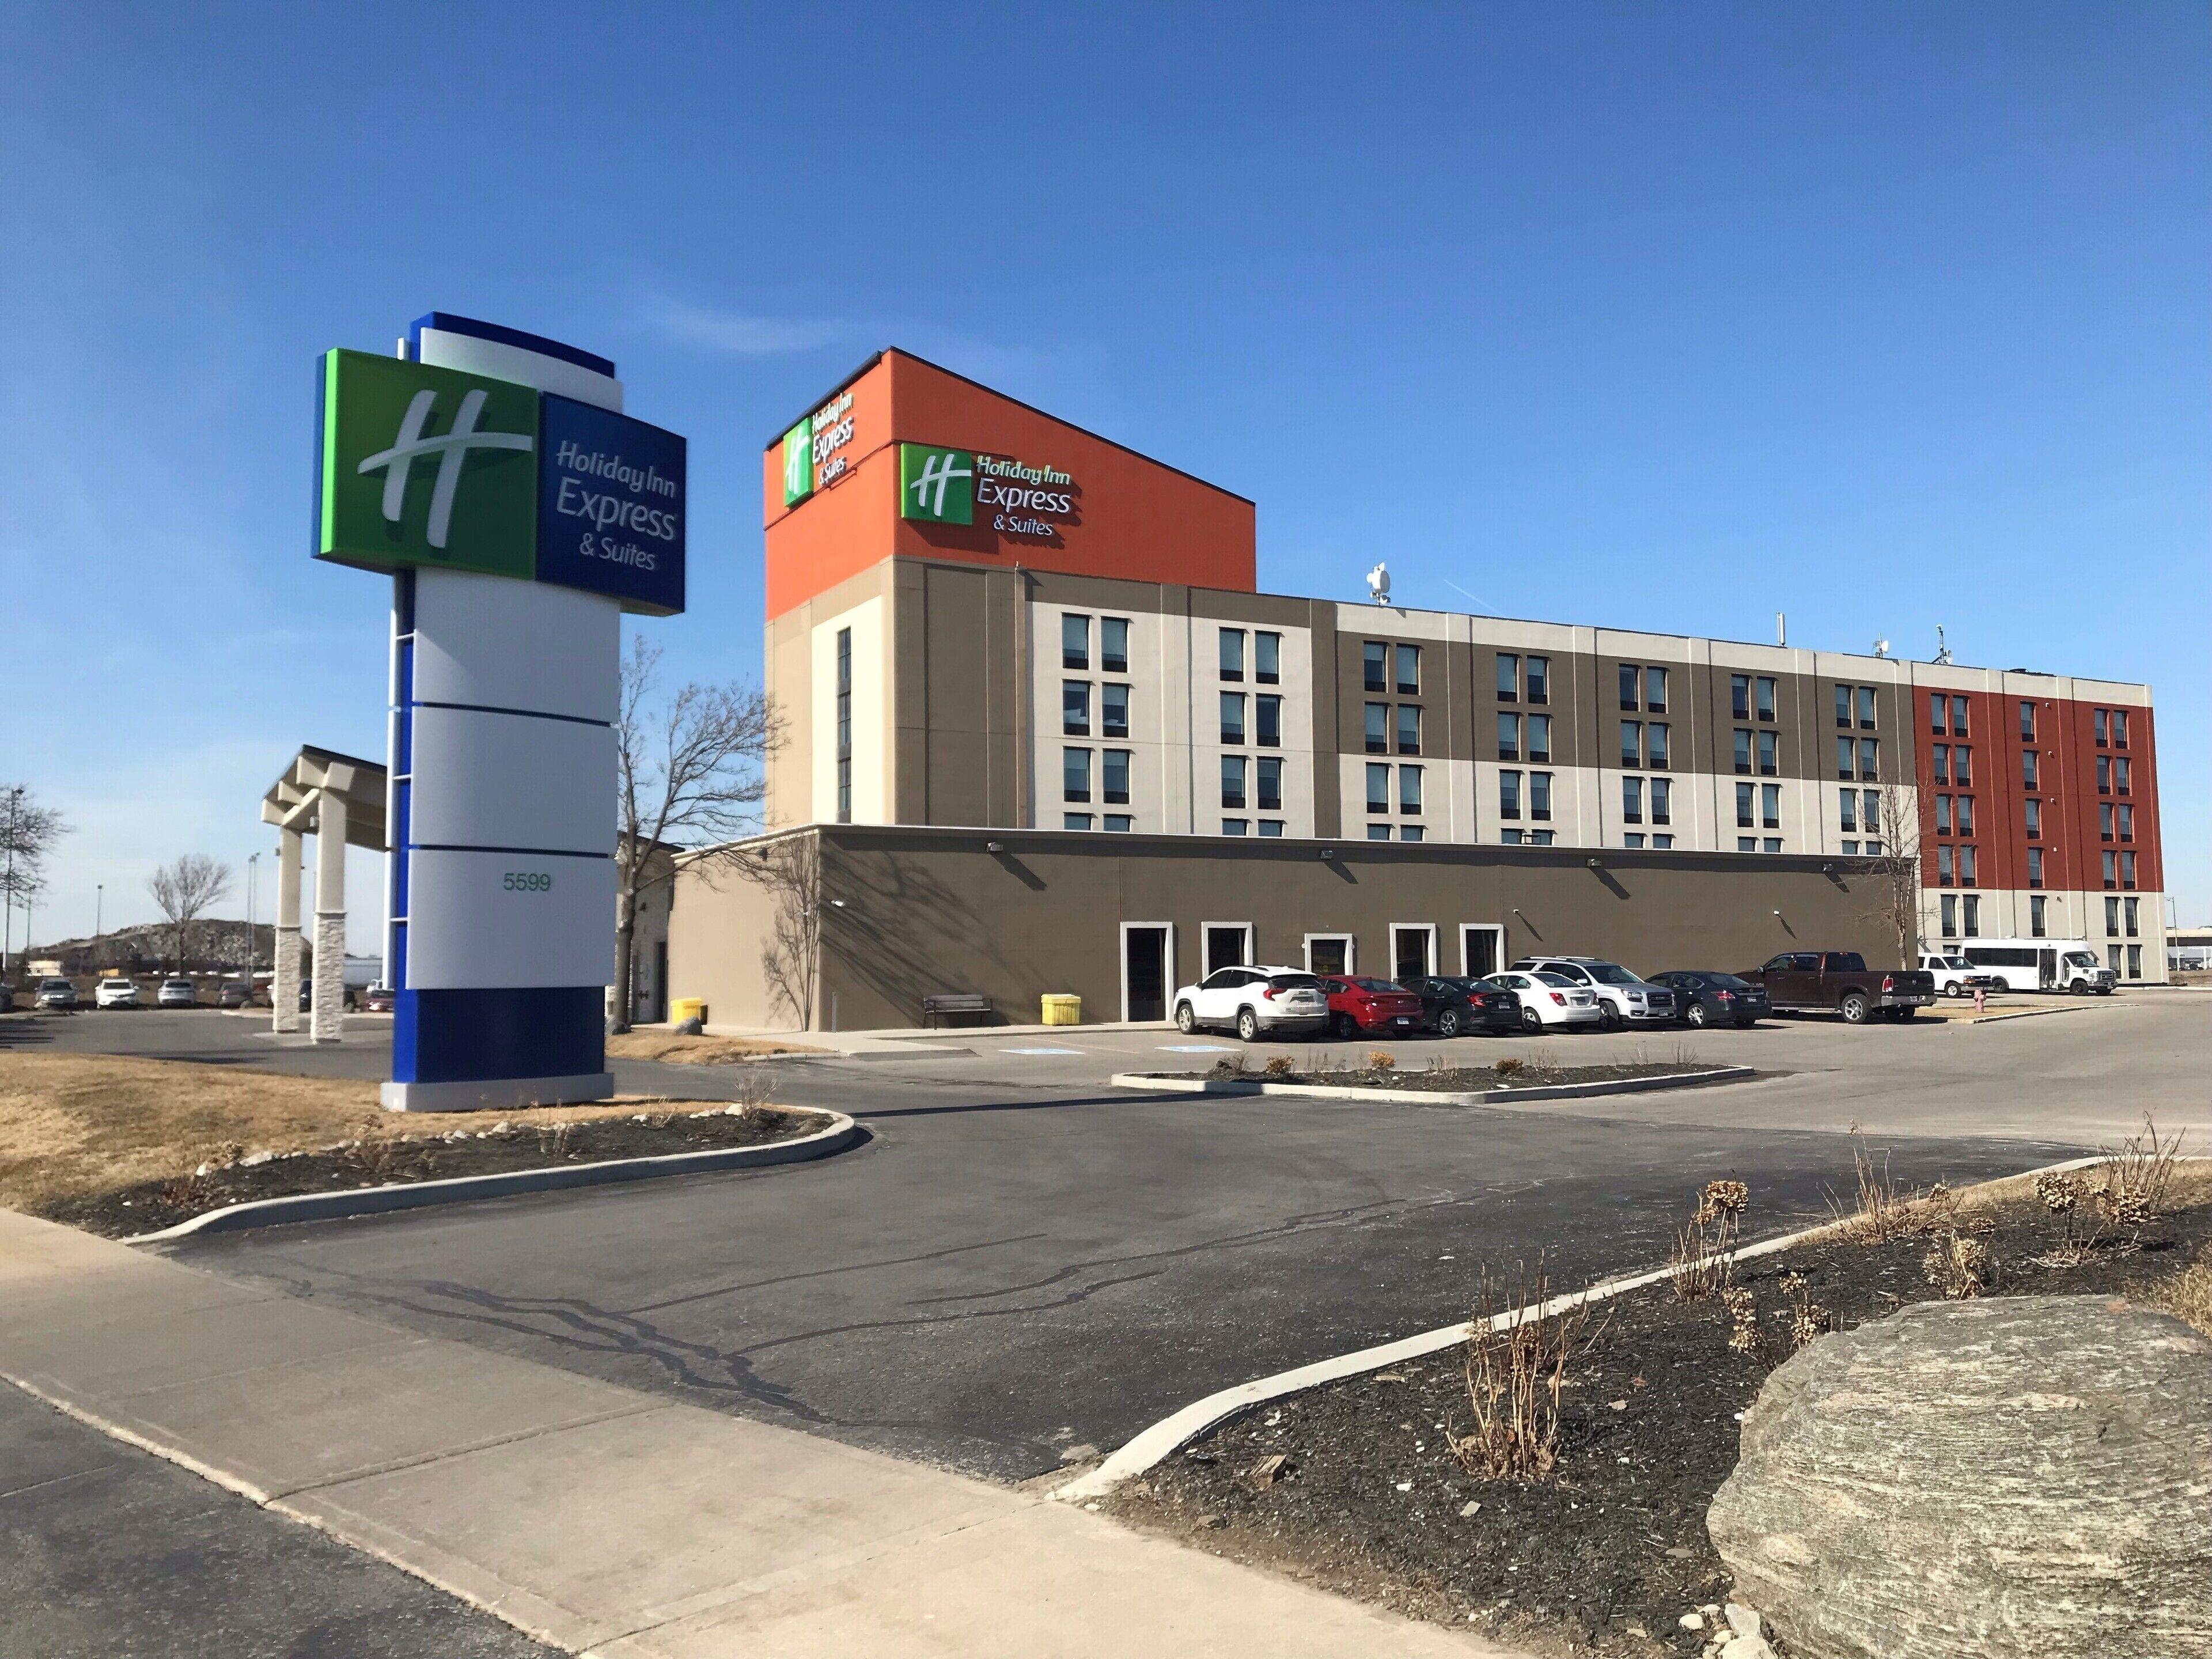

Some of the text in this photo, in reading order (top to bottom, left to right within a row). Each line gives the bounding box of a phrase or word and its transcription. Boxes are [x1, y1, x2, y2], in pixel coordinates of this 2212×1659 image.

[812, 392, 854, 434] Holiday Inn
[812, 416, 854, 464] Express
[556, 440, 675, 498] Holiday Inn
[819, 457, 846, 485] & Suites
[976, 454, 1070, 486] Holiday Inn
[556, 476, 676, 541] Express
[977, 477, 1071, 513] Express
[993, 514, 1053, 536] & Suites
[579, 532, 656, 571] & Suites
[503, 872, 551, 892] 5599
